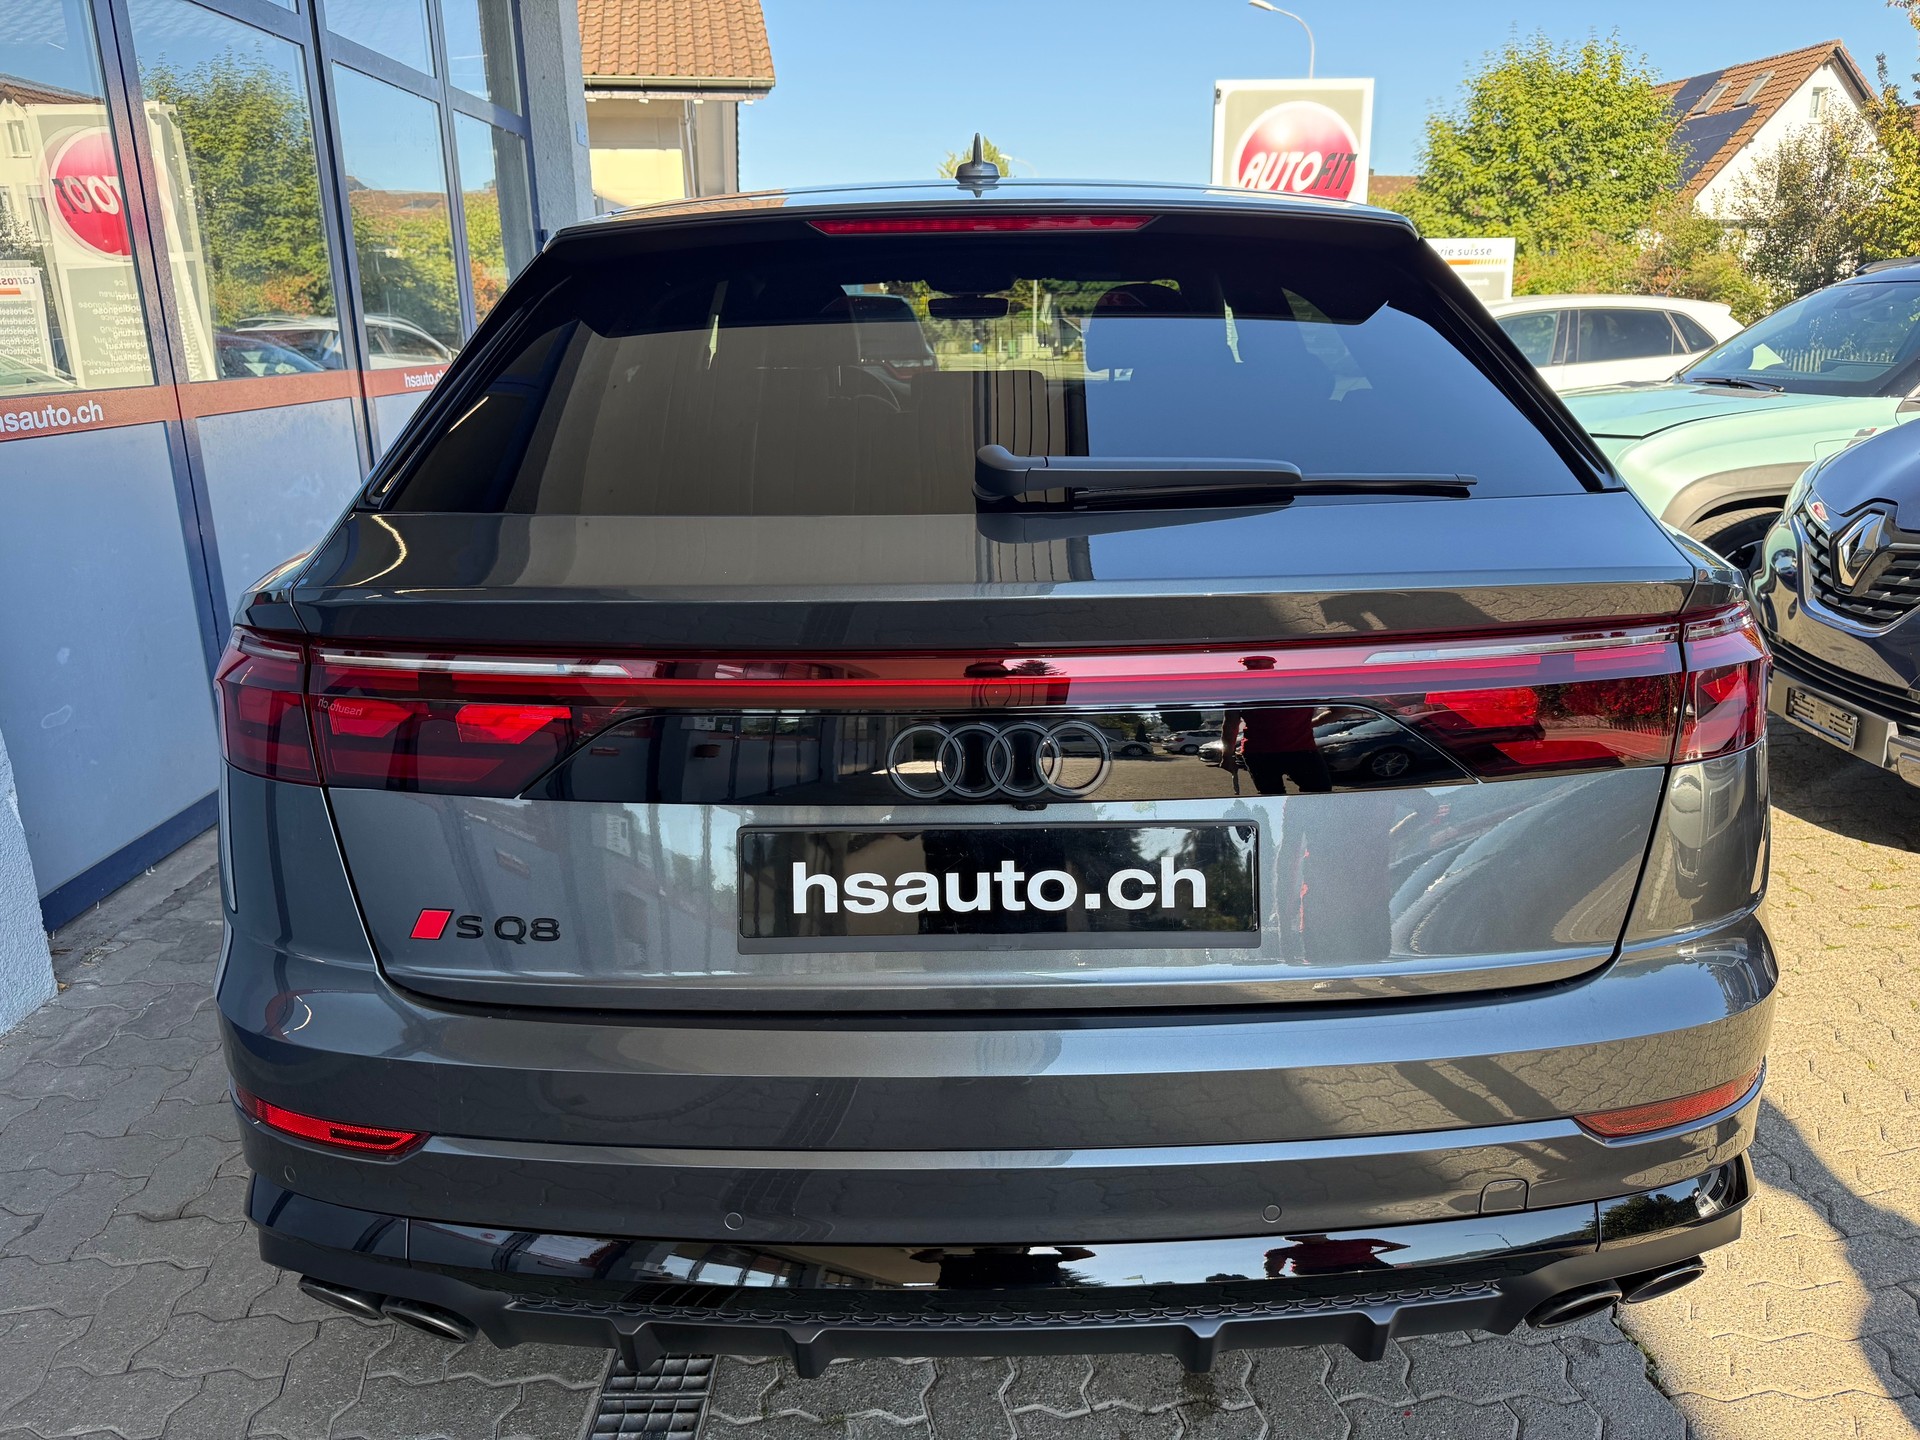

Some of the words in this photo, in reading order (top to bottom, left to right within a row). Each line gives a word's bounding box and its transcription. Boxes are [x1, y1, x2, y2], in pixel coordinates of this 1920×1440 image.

[1239, 151, 1358, 192] AUTOFIT
[1457, 246, 1492, 256] suisse
[792, 856, 1207, 914] hsauto.ch
